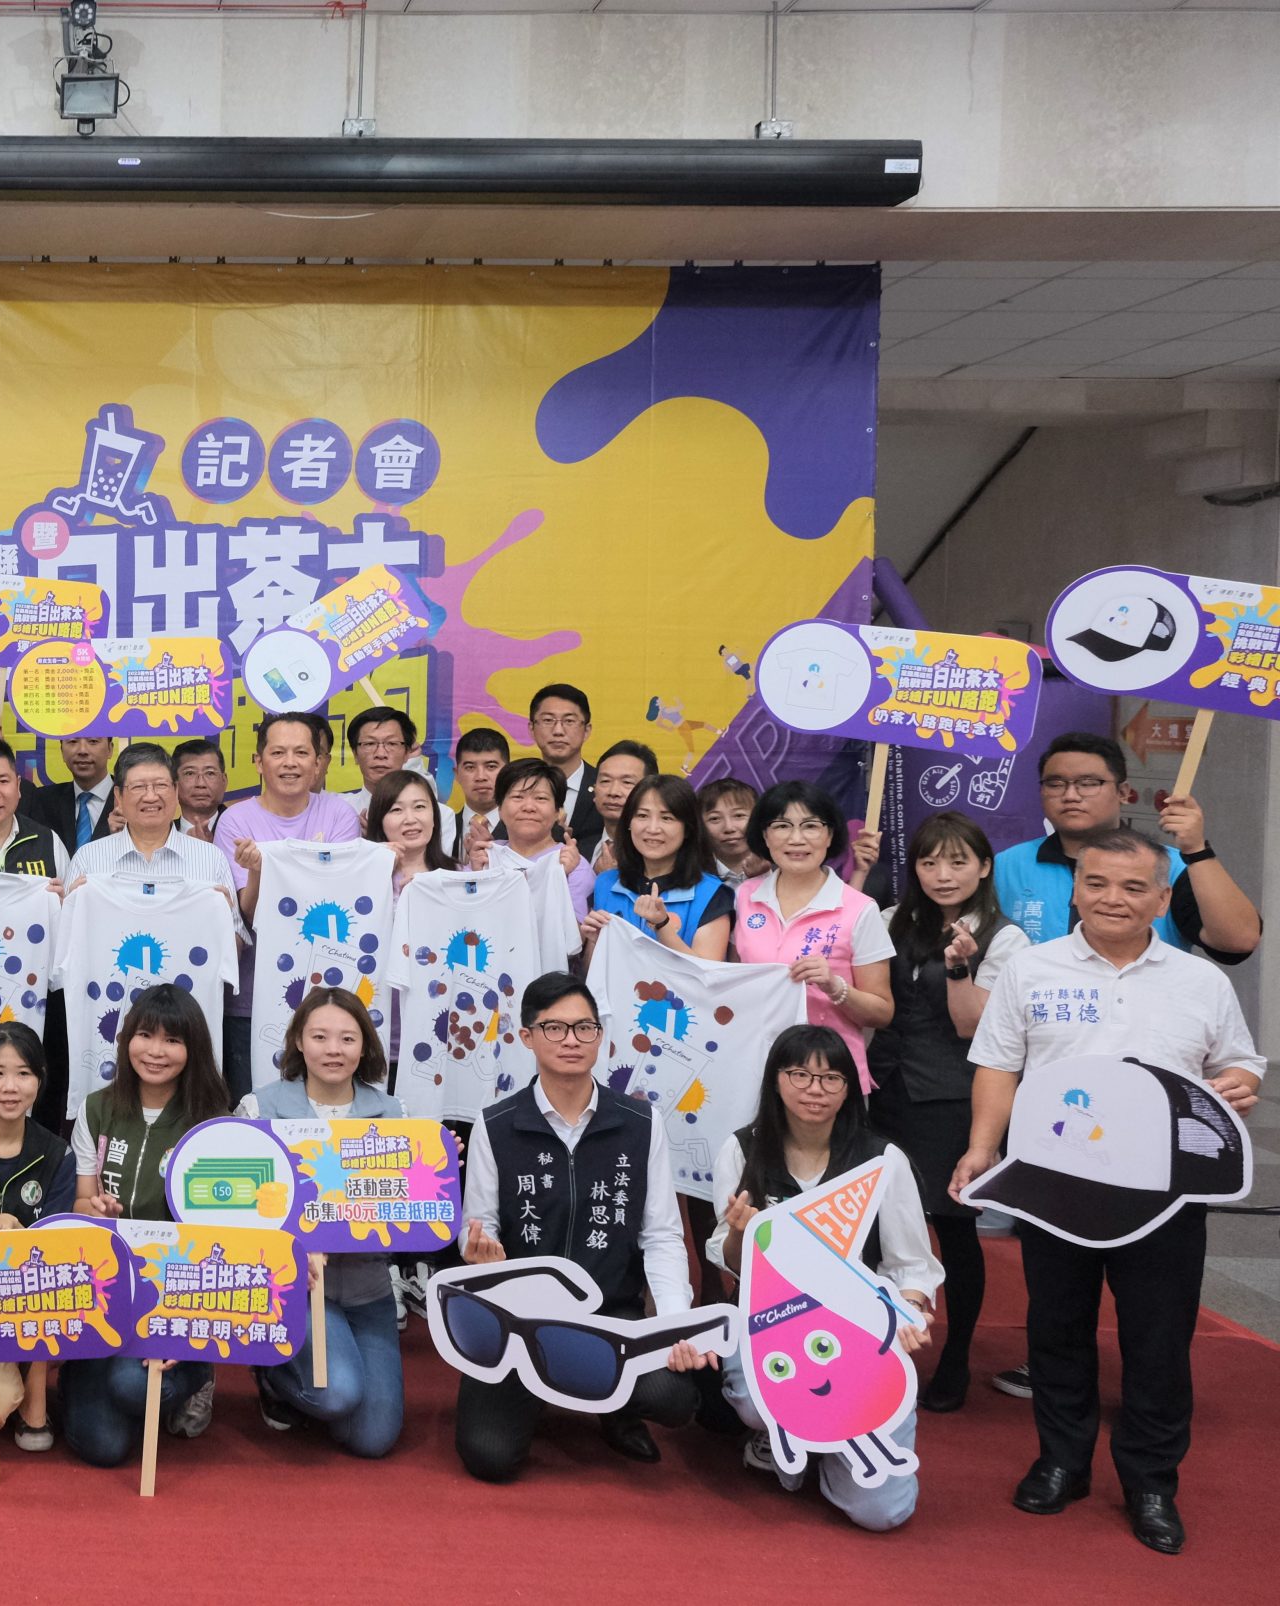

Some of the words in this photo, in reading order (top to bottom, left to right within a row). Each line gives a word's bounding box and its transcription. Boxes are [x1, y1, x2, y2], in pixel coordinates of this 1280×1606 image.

[196, 433, 424, 489] 記者會
[32, 521, 58, 551] 暨
[39, 603, 83, 622] 日出茶太
[156, 667, 208, 689] 日出茶太
[933, 667, 1000, 689] 日出茶太
[1220, 672, 1280, 695] 經典
[896, 690, 998, 713] 彩繪FUN路跑
[873, 708, 1006, 738] 奶茶人路跑紀念衫
[1031, 989, 1099, 1000] 新竹縣議員
[1031, 1003, 1100, 1023] 楊昌德
[364, 1136, 408, 1155] 日出茶太
[537, 1152, 554, 1189] 秘書
[213, 1186, 231, 1197] 150
[348, 1178, 408, 1197] 活動當天
[612, 1153, 631, 1226] 立法委員
[517, 1174, 541, 1245] 周大偉
[585, 1181, 611, 1250] 林思銘
[803, 1173, 879, 1250] FIGHT
[23, 1262, 90, 1293] 日出茶太
[165, 1278, 201, 1292] 挑戰賽
[201, 1265, 268, 1291] 日出茶太
[164, 1288, 269, 1313] 彩繪FUN路跑
[766, 1301, 808, 1324] Chatime
[0, 1319, 83, 1338] 完賽獎牌
[149, 1316, 288, 1343] 完賽證明+保險
